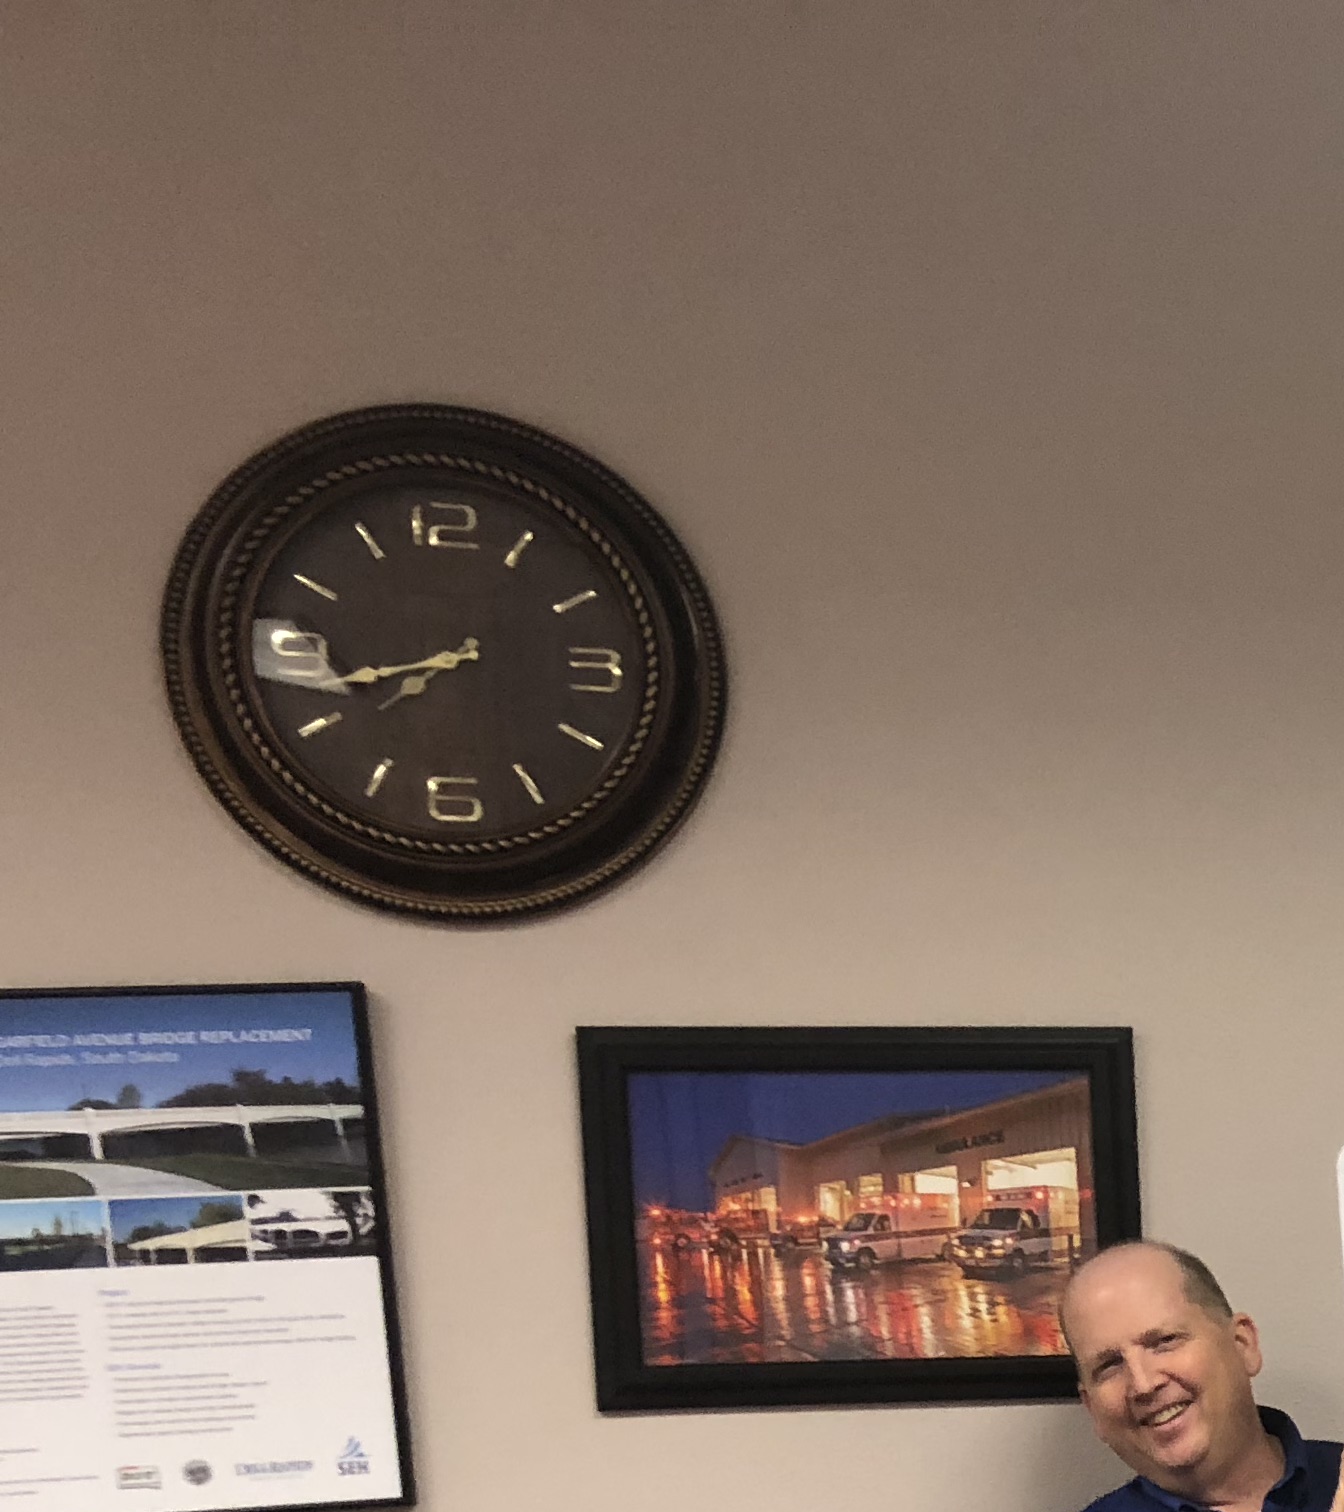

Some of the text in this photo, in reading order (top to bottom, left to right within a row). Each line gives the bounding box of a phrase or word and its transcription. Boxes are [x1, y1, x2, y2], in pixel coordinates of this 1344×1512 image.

[410, 501, 480, 550] 12
[269, 628, 329, 679] 9
[567, 645, 623, 693] 3
[426, 776, 484, 823] 6
